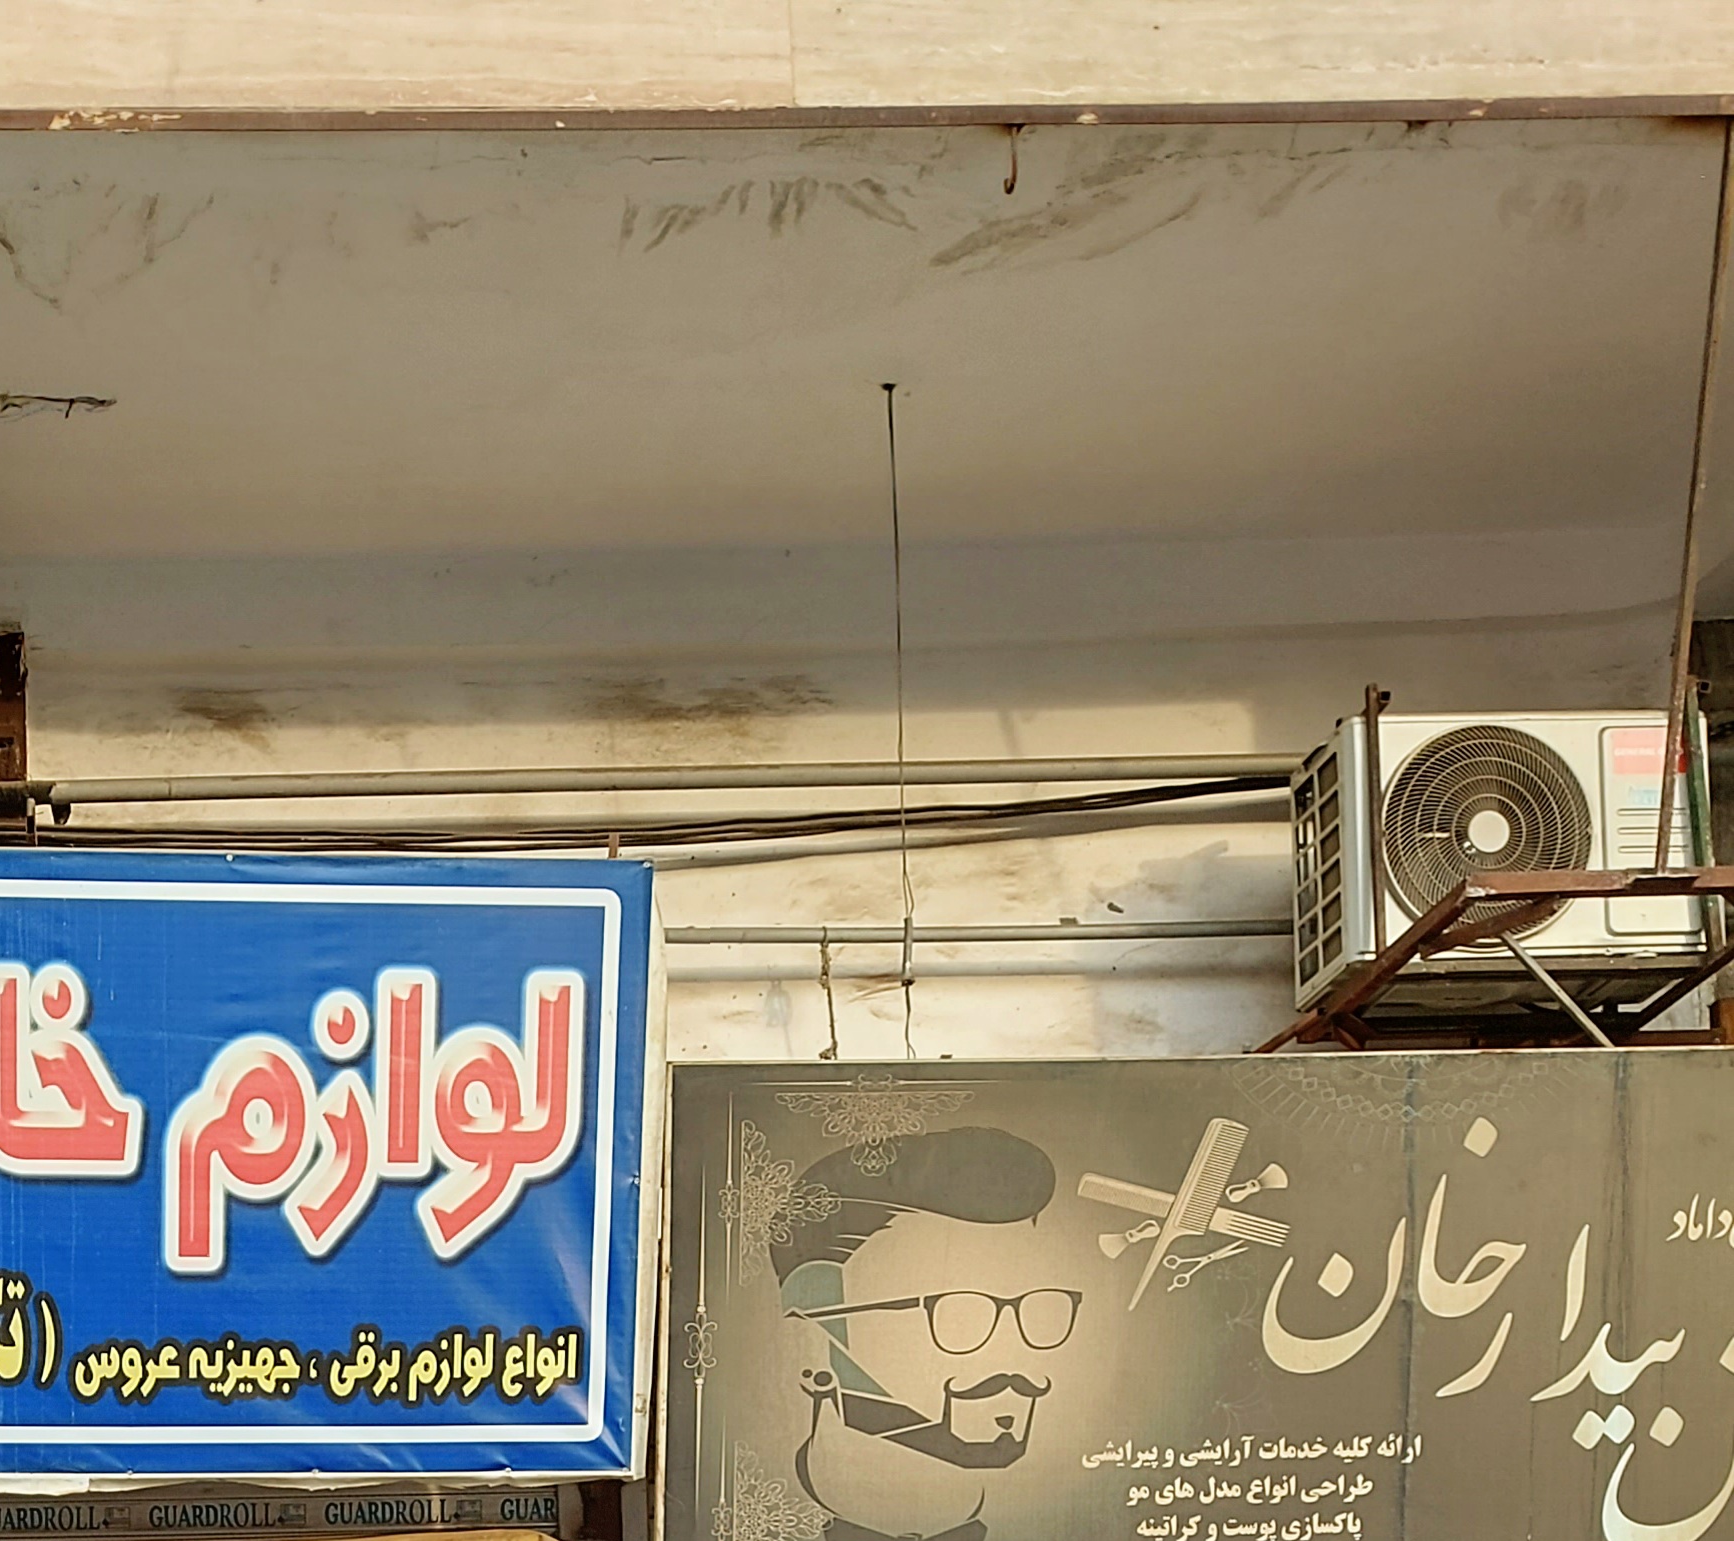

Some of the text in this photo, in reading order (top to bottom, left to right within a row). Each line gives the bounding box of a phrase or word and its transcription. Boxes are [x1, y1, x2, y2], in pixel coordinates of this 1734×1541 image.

[164, 967, 584, 1273] لوازم
[1260, 1116, 1528, 1376] خان
[74, 1344, 181, 1399] عروس
[187, 1339, 302, 1396] جهیزیه
[407, 1332, 496, 1402] لوازم
[502, 1331, 579, 1398] انواع
[1081, 1439, 1160, 1469] پیرایشی
[1162, 1446, 1176, 1469] و
[1178, 1436, 1256, 1469] آرایشی
[1258, 1437, 1329, 1461] خدمات
[1332, 1436, 1373, 1465] کلیه
[1126, 1473, 1374, 1507] طراحی انواع مدل های مو
[148, 1502, 278, 1529] GUARDROLL
[323, 1500, 453, 1525] GUARDROLL
[1280, 1512, 1364, 1541] پاکسازی
